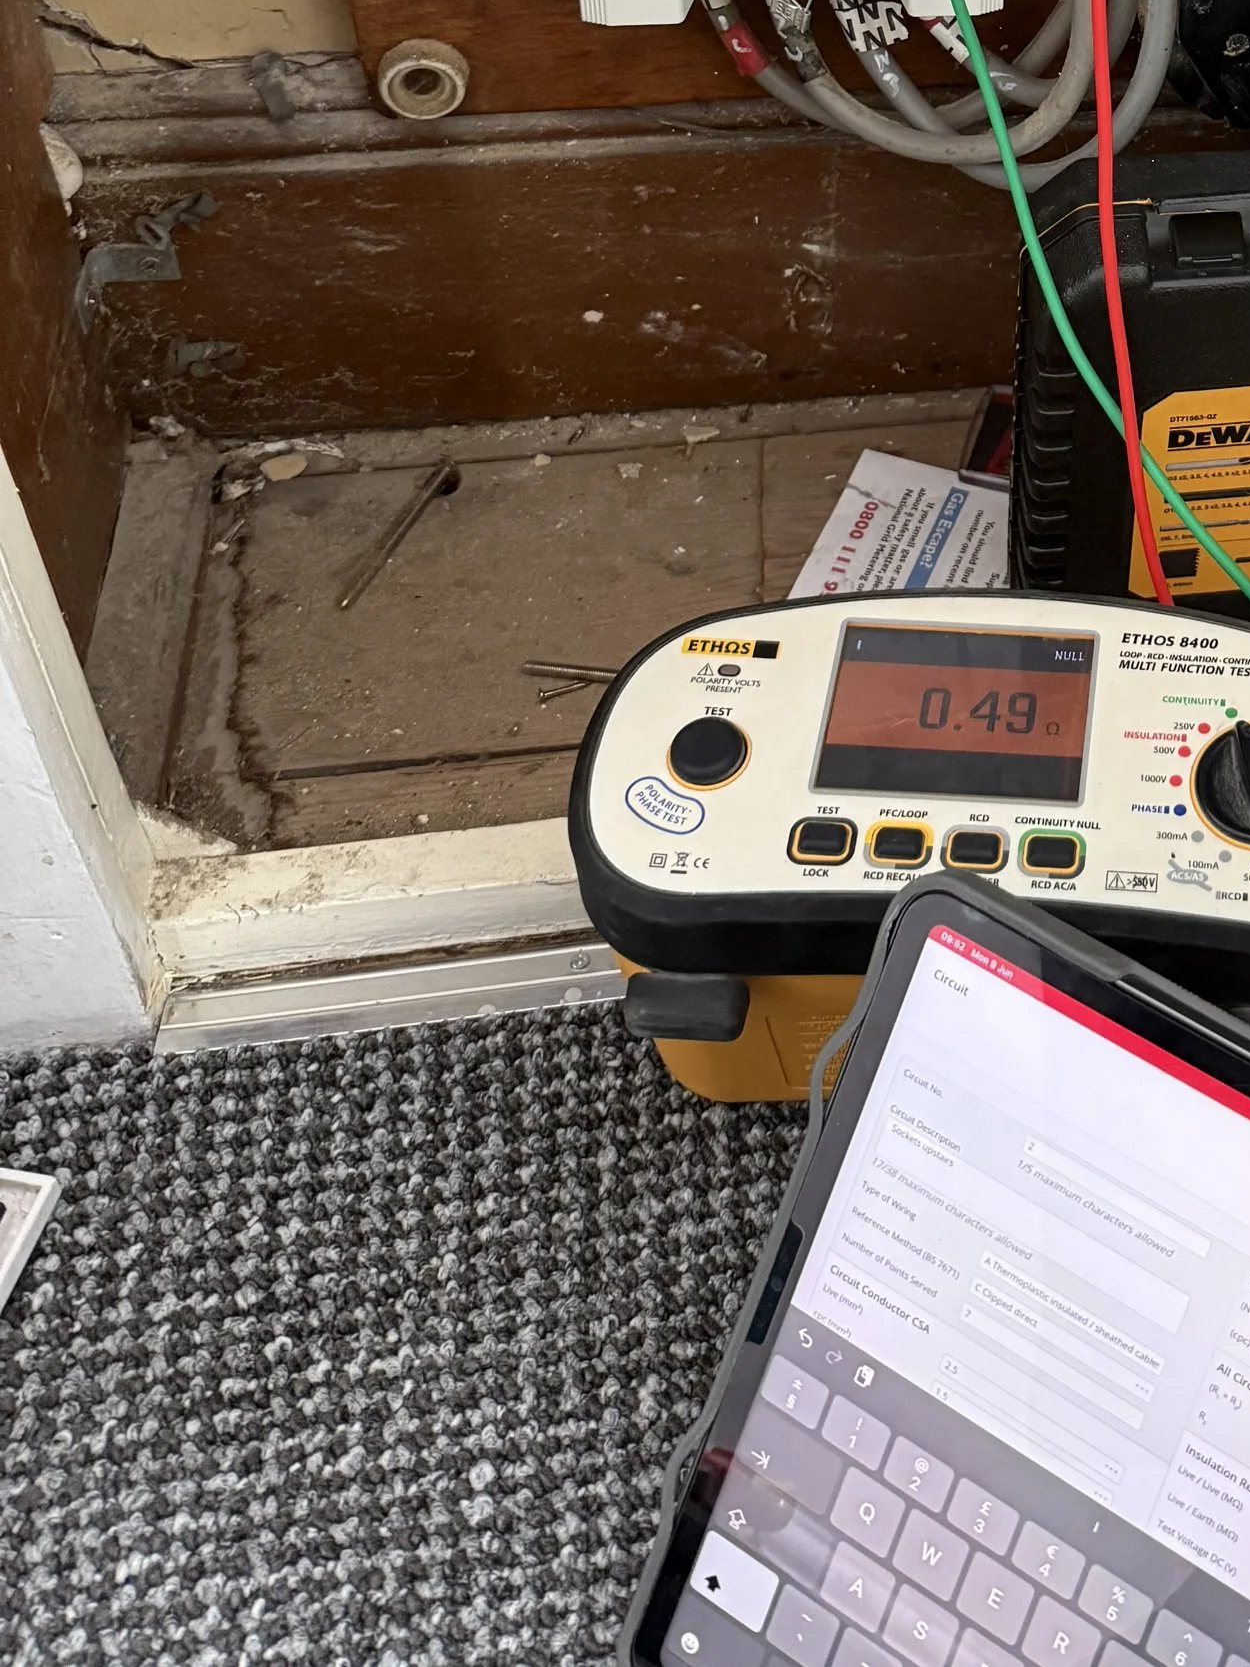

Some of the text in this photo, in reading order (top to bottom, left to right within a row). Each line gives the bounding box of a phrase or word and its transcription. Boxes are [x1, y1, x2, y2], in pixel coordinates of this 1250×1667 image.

[891, 488, 914, 523] National
[912, 487, 927, 512] about
[849, 500, 880, 540] 0800
[920, 492, 964, 569] Gas Escape?
[964, 509, 984, 545] number
[882, 524, 897, 545] Grid
[900, 524, 922, 565] smell gas
[862, 544, 883, 581] Metering
[1121, 632, 1219, 650] ETHOS 8400
[1053, 649, 1085, 662] NULL
[1119, 650, 1143, 659] LOOP
[1146, 652, 1165, 661] RCD
[1168, 653, 1219, 664] INSULATION
[1118, 659, 1156, 672] MULTI
[1160, 662, 1225, 677] FUNCTION
[690, 675, 761, 688] POLARITY VOLTS
[704, 684, 743, 695] PRESENT
[703, 705, 733, 717] TEST
[1123, 730, 1182, 743] INSULATION
[1173, 722, 1196, 731] 250V
[1153, 745, 1176, 755] 500V
[1140, 773, 1167, 784] 1000V
[816, 805, 1102, 831] TEST PFC/LOOP RCD CONTINUITY NULL
[1155, 830, 1188, 841] 300mA
[1187, 859, 1220, 870] 100mA
[933, 968, 970, 997] Circuit
[889, 1103, 962, 1154] Circuit Description
[890, 1123, 955, 1168] Sockets upstairs
[871, 1155, 1035, 1262] 17/38 maximum characters allowed
[1016, 1158, 1176, 1259] 1/5 maximum characters allowed
[829, 1263, 931, 1335] Circuit Conductor CSA
[1215, 1362, 1233, 1378] All
[1184, 1443, 1239, 1485] Insulation
[859, 1501, 876, 1526] Q
[920, 1540, 943, 1567] W
[848, 1577, 864, 1599] A
[987, 1586, 1004, 1610] E
[913, 1619, 929, 1641] S
[1052, 1630, 1070, 1655] R
